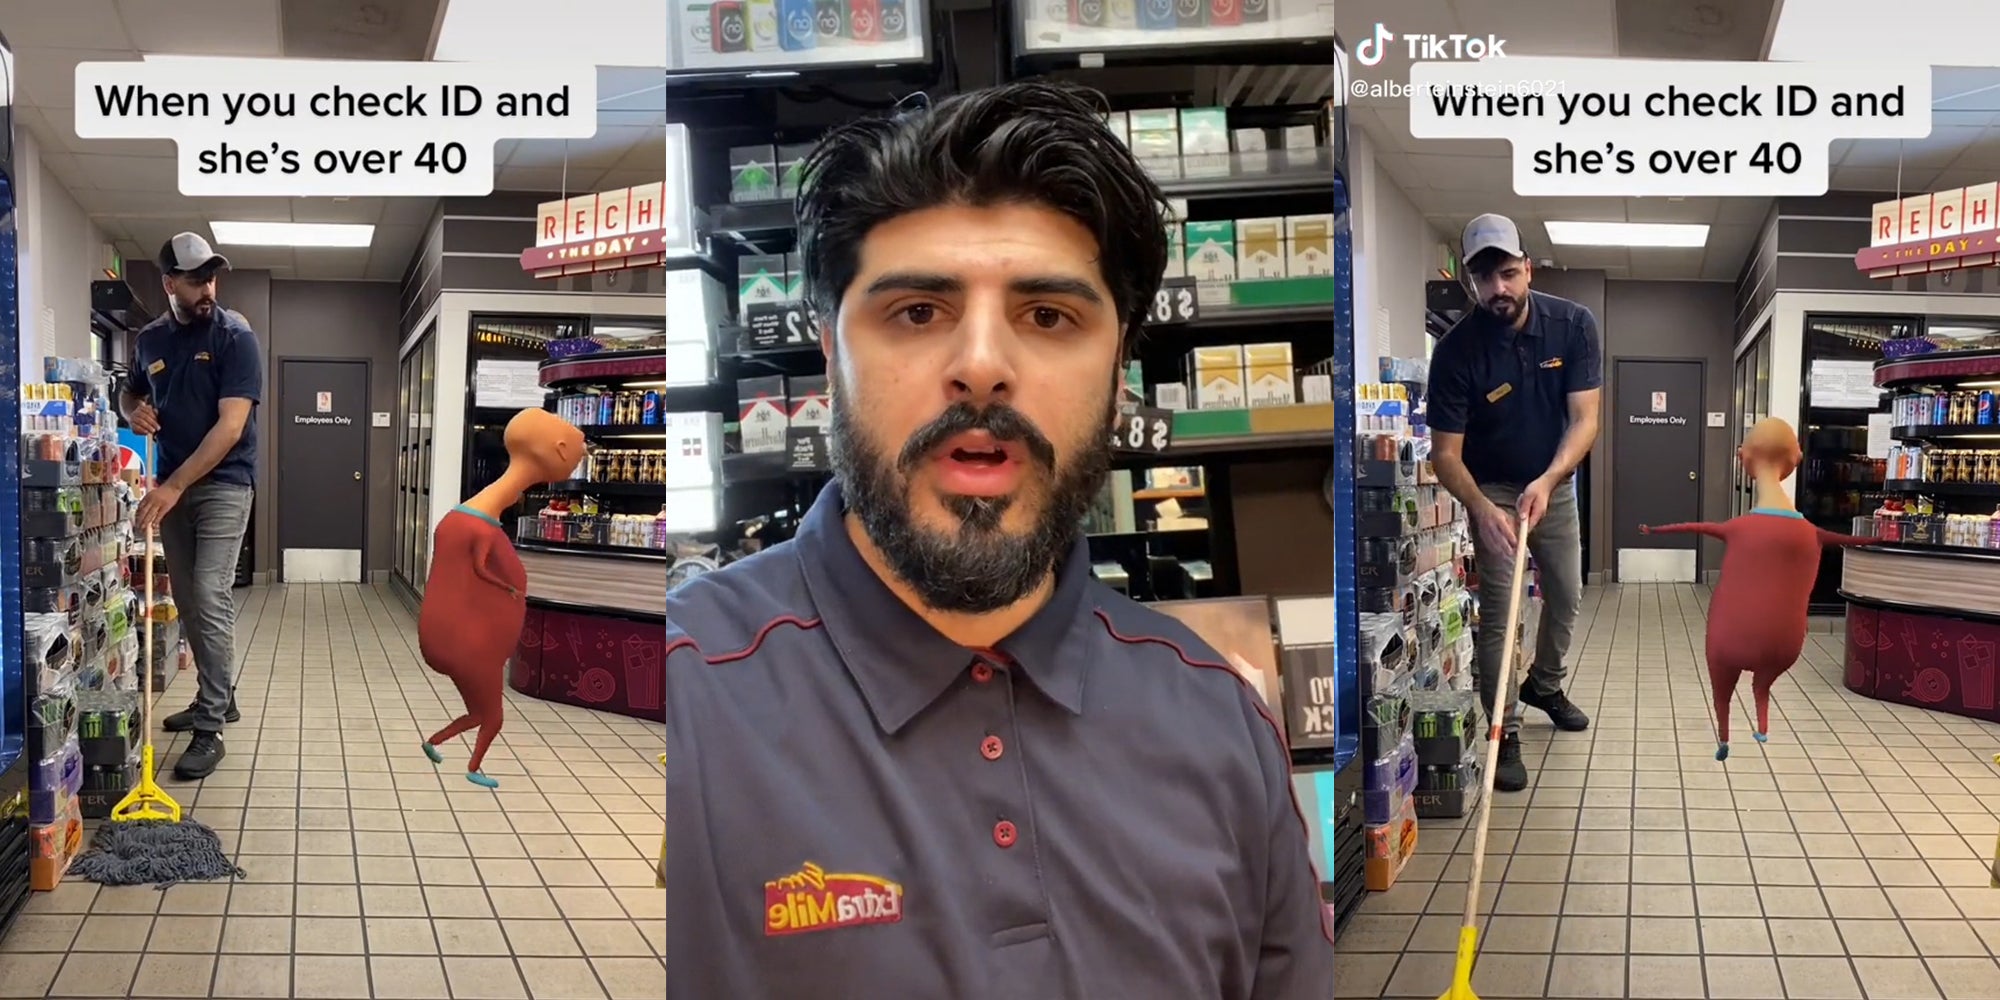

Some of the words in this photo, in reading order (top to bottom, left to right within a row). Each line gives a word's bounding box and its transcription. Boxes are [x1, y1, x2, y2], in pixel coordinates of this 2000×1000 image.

[544, 199, 653, 240] RECH
[1879, 199, 1987, 240] RECH
[559, 245, 590, 259] THE
[594, 237, 636, 257] DAY
[1895, 249, 1923, 259] THE
[1929, 237, 1969, 256] DAY
[294, 415, 334, 425] Employees
[334, 416, 352, 426] Only
[1629, 415, 1669, 425] Employees
[1669, 416, 1687, 426] Only
